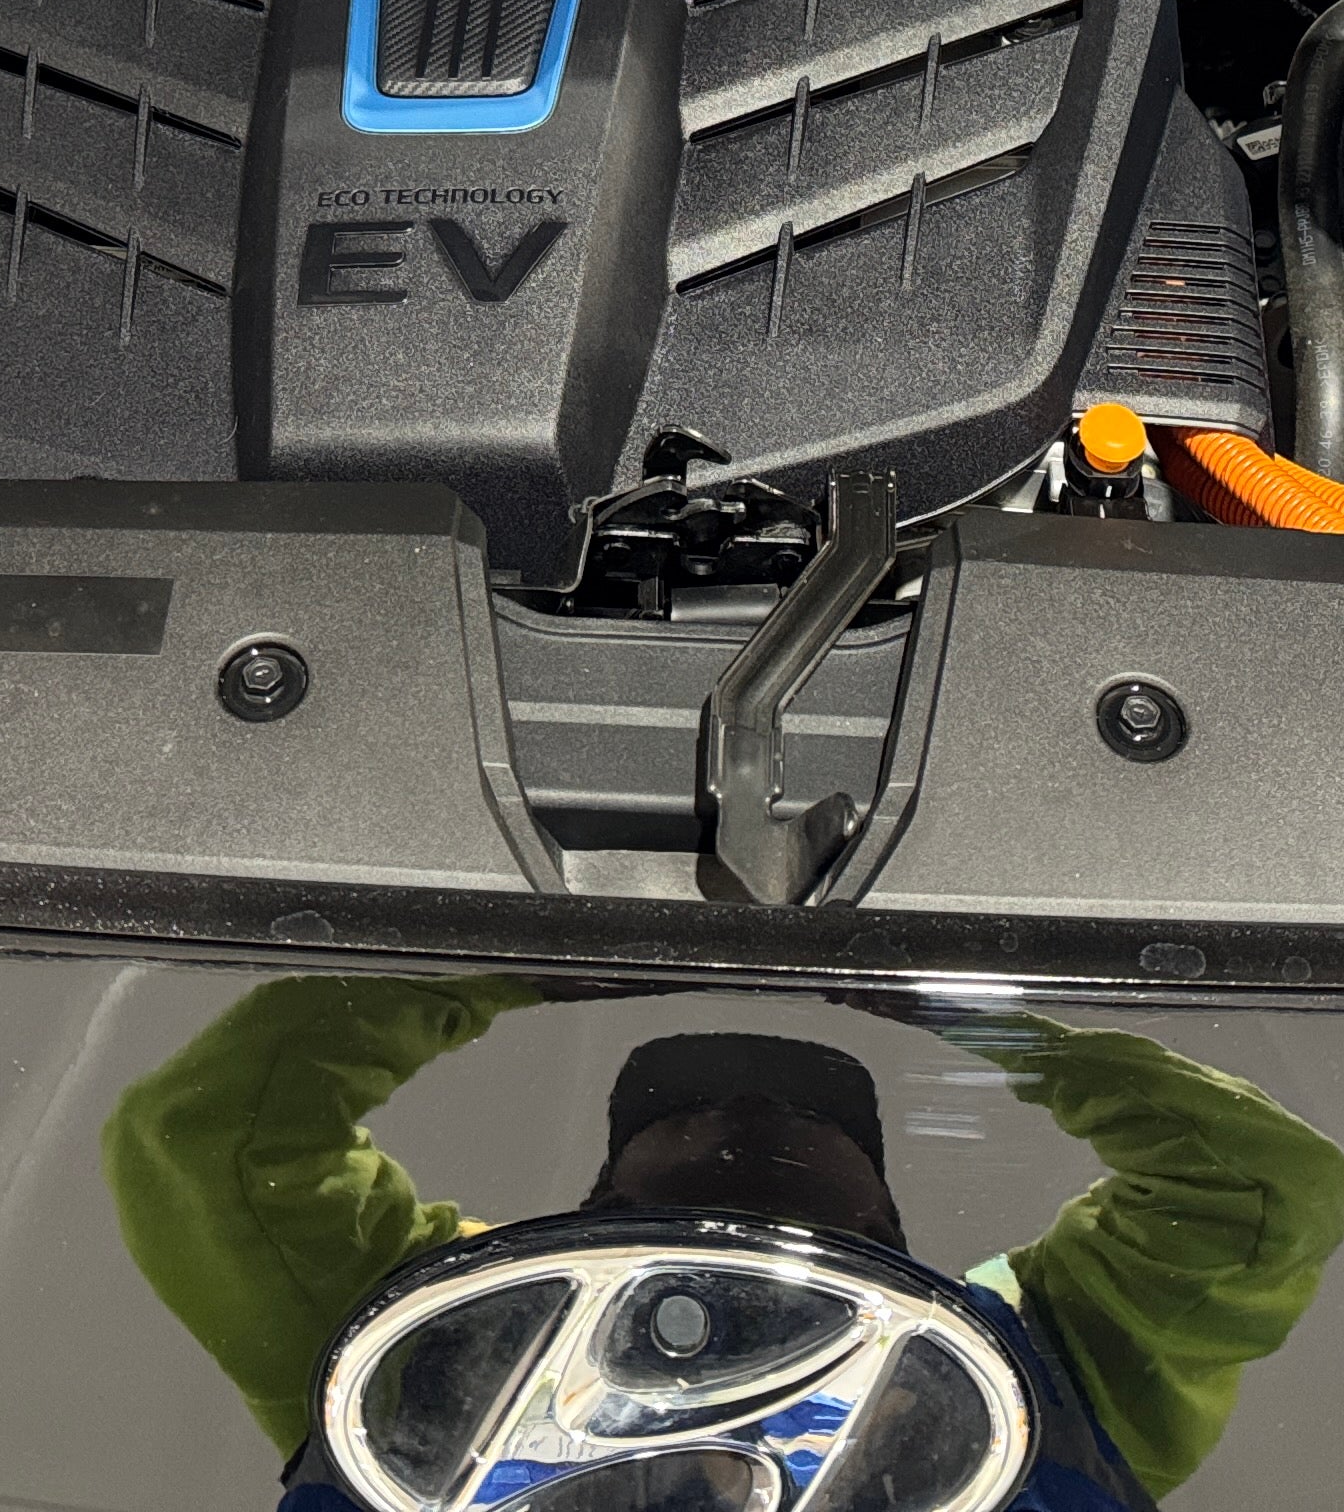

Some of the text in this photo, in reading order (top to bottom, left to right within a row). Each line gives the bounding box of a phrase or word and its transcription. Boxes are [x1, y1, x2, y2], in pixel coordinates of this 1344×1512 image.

[316, 187, 565, 208] ECO TECHNOLOGY
[296, 217, 568, 307] EV
[1319, 429, 1334, 450] 46
